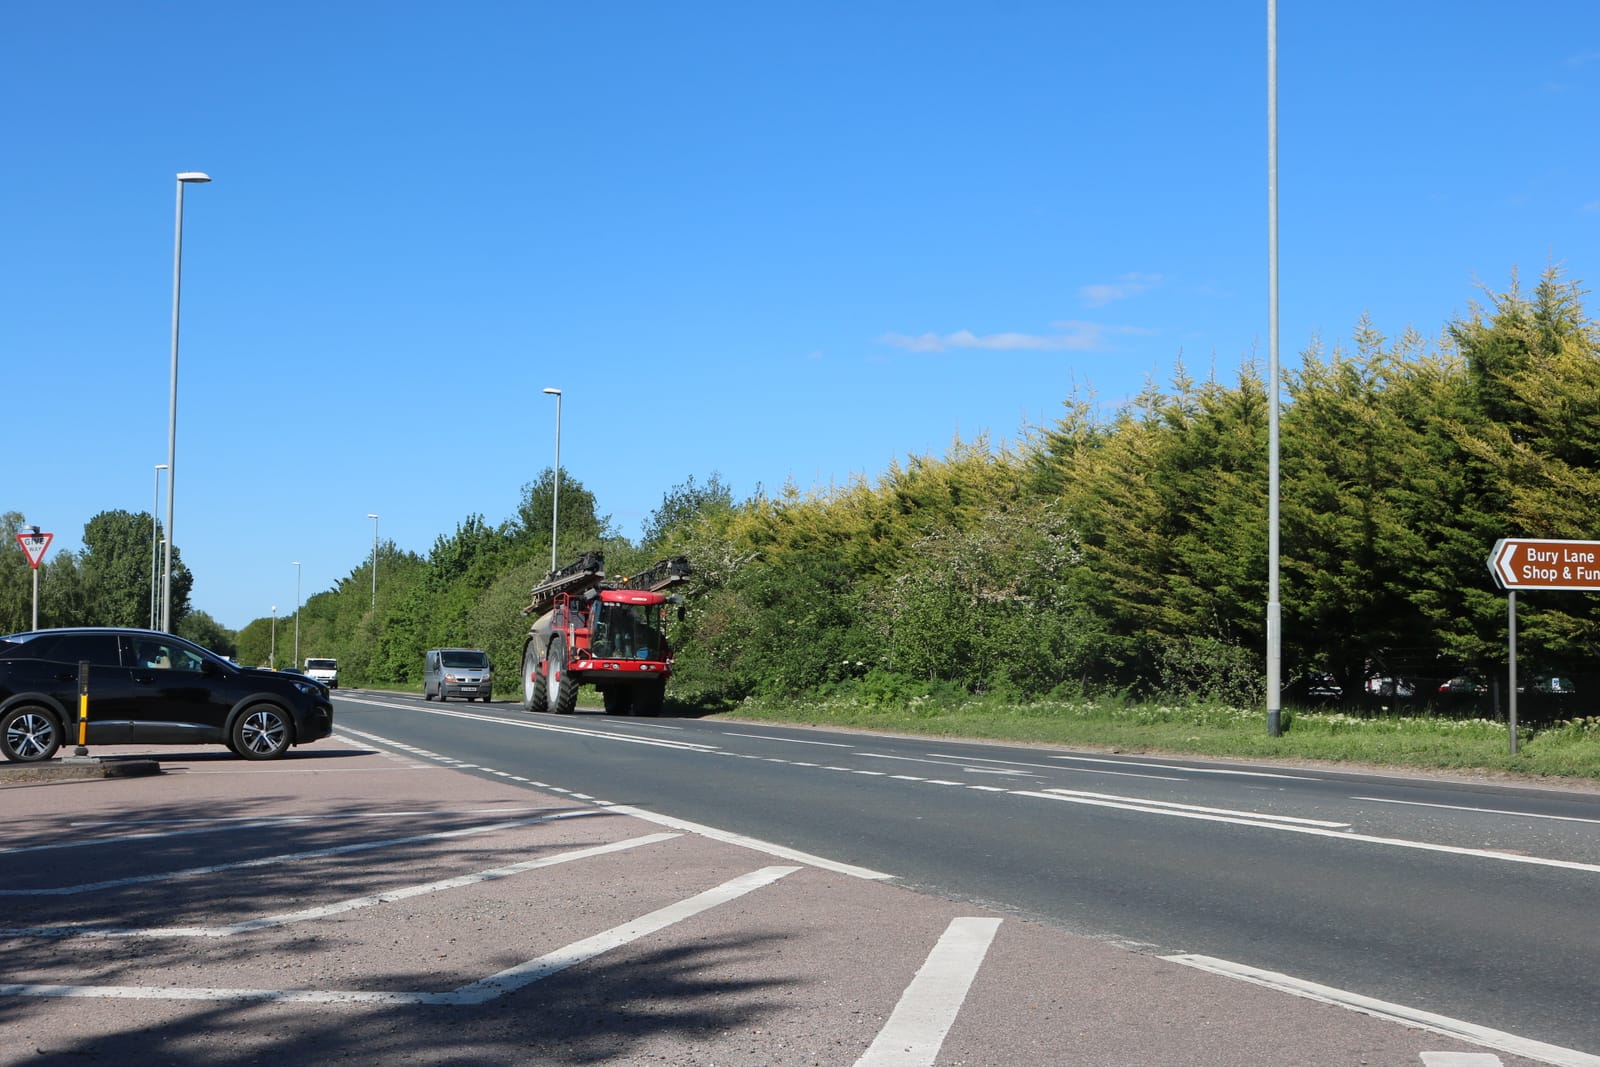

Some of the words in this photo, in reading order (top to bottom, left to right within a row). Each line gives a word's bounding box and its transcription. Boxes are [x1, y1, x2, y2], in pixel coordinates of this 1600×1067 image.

[1527, 547, 1559, 565] Bury
[1563, 548, 1595, 563] Lane
[1522, 565, 1558, 582] Shop
[1562, 566, 1572, 580] &
[1576, 566, 1600, 580] Fun
